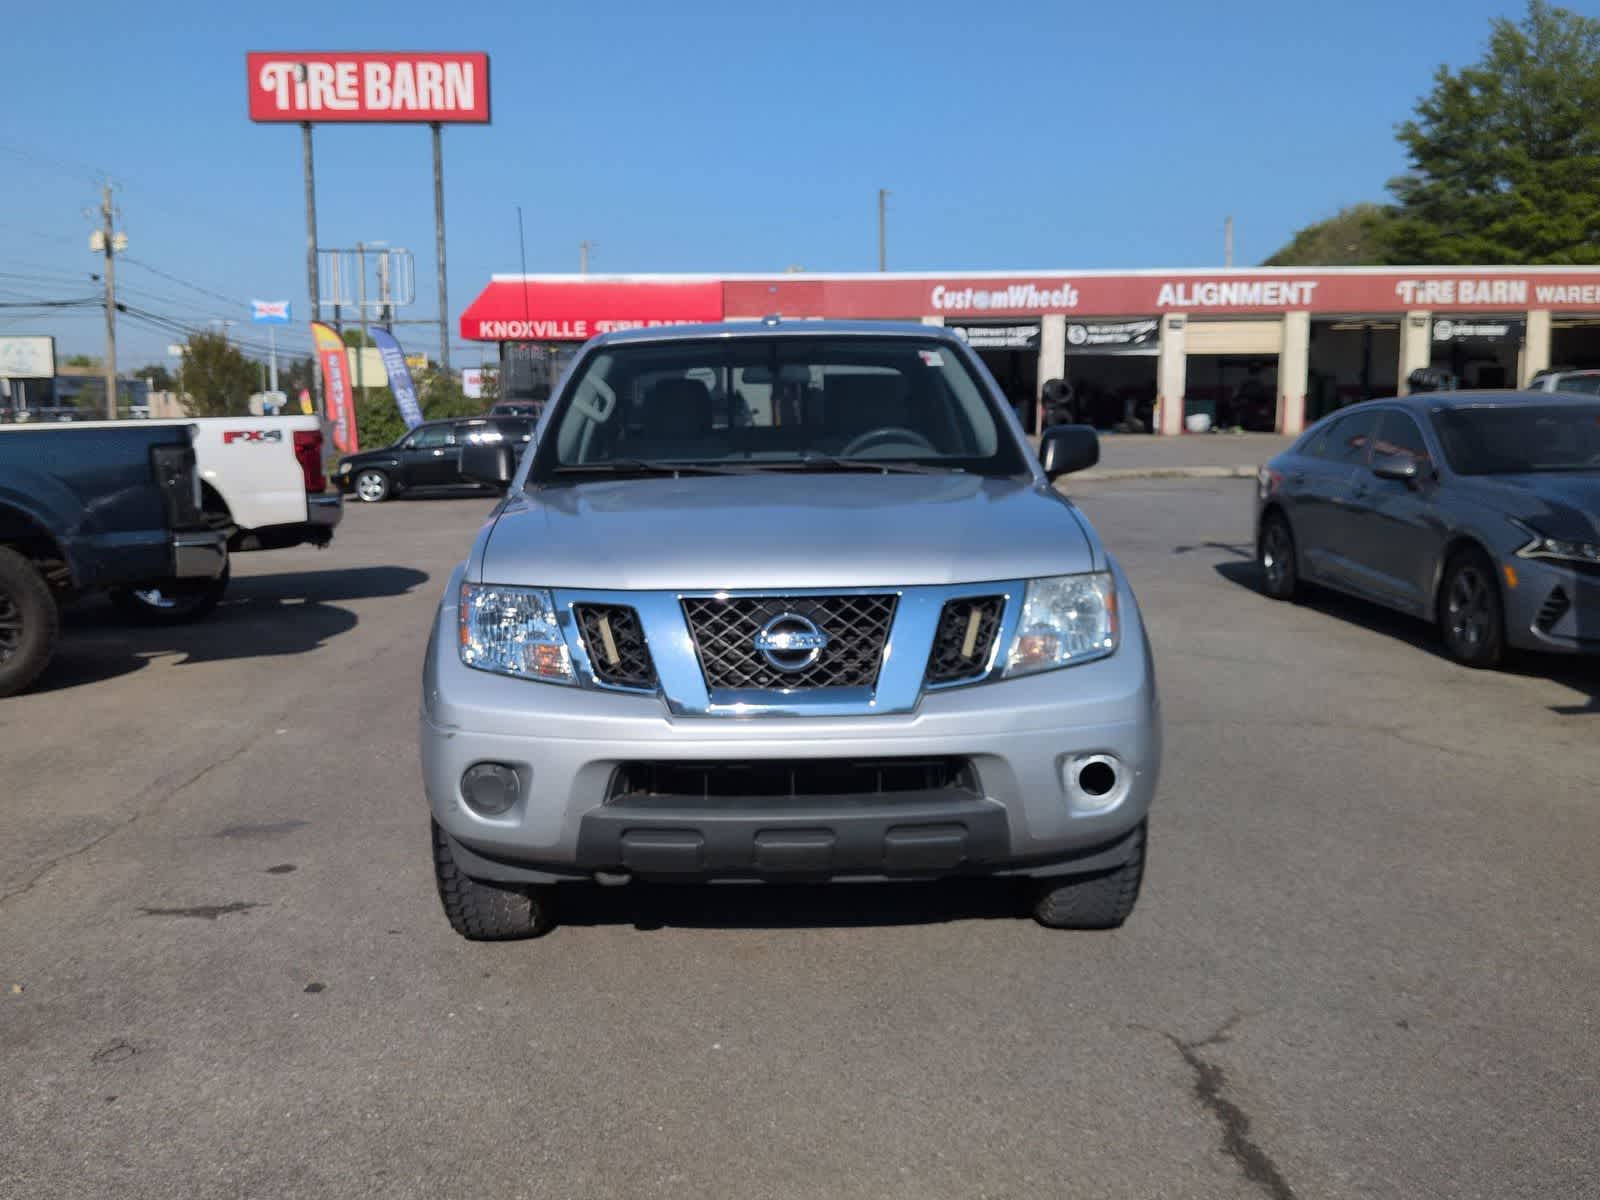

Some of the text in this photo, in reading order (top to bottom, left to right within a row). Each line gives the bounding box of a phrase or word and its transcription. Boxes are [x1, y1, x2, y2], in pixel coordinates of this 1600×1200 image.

[363, 62, 476, 111] BARN
[1156, 281, 1319, 307] ALIGNMENT
[1457, 280, 1528, 304] BARN
[479, 320, 588, 338] KNOXVILLE
[223, 431, 282, 444] FX4
